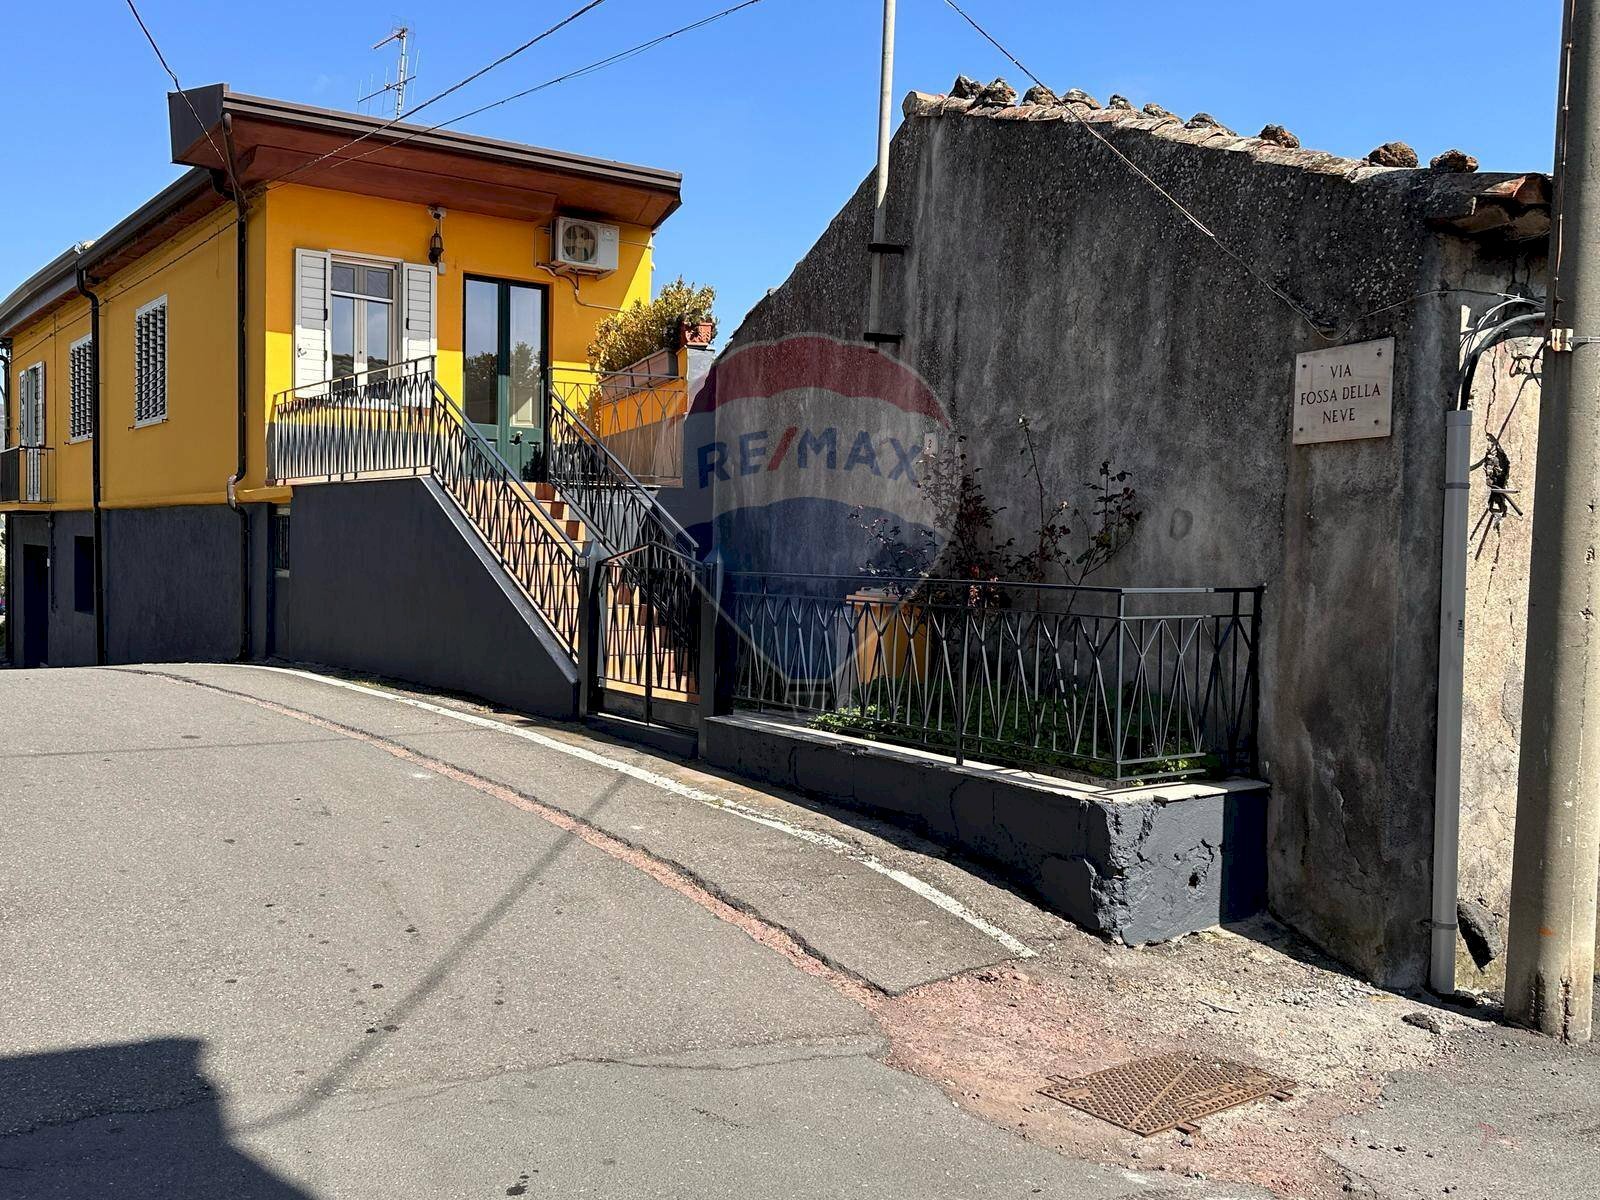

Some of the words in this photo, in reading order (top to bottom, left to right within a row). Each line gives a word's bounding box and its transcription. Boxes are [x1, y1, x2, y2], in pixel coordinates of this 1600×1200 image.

[1330, 364, 1352, 378] VIA
[1300, 388, 1338, 406] FOSSA
[1342, 383, 1381, 400] DELLA
[1322, 407, 1356, 424] NEVE
